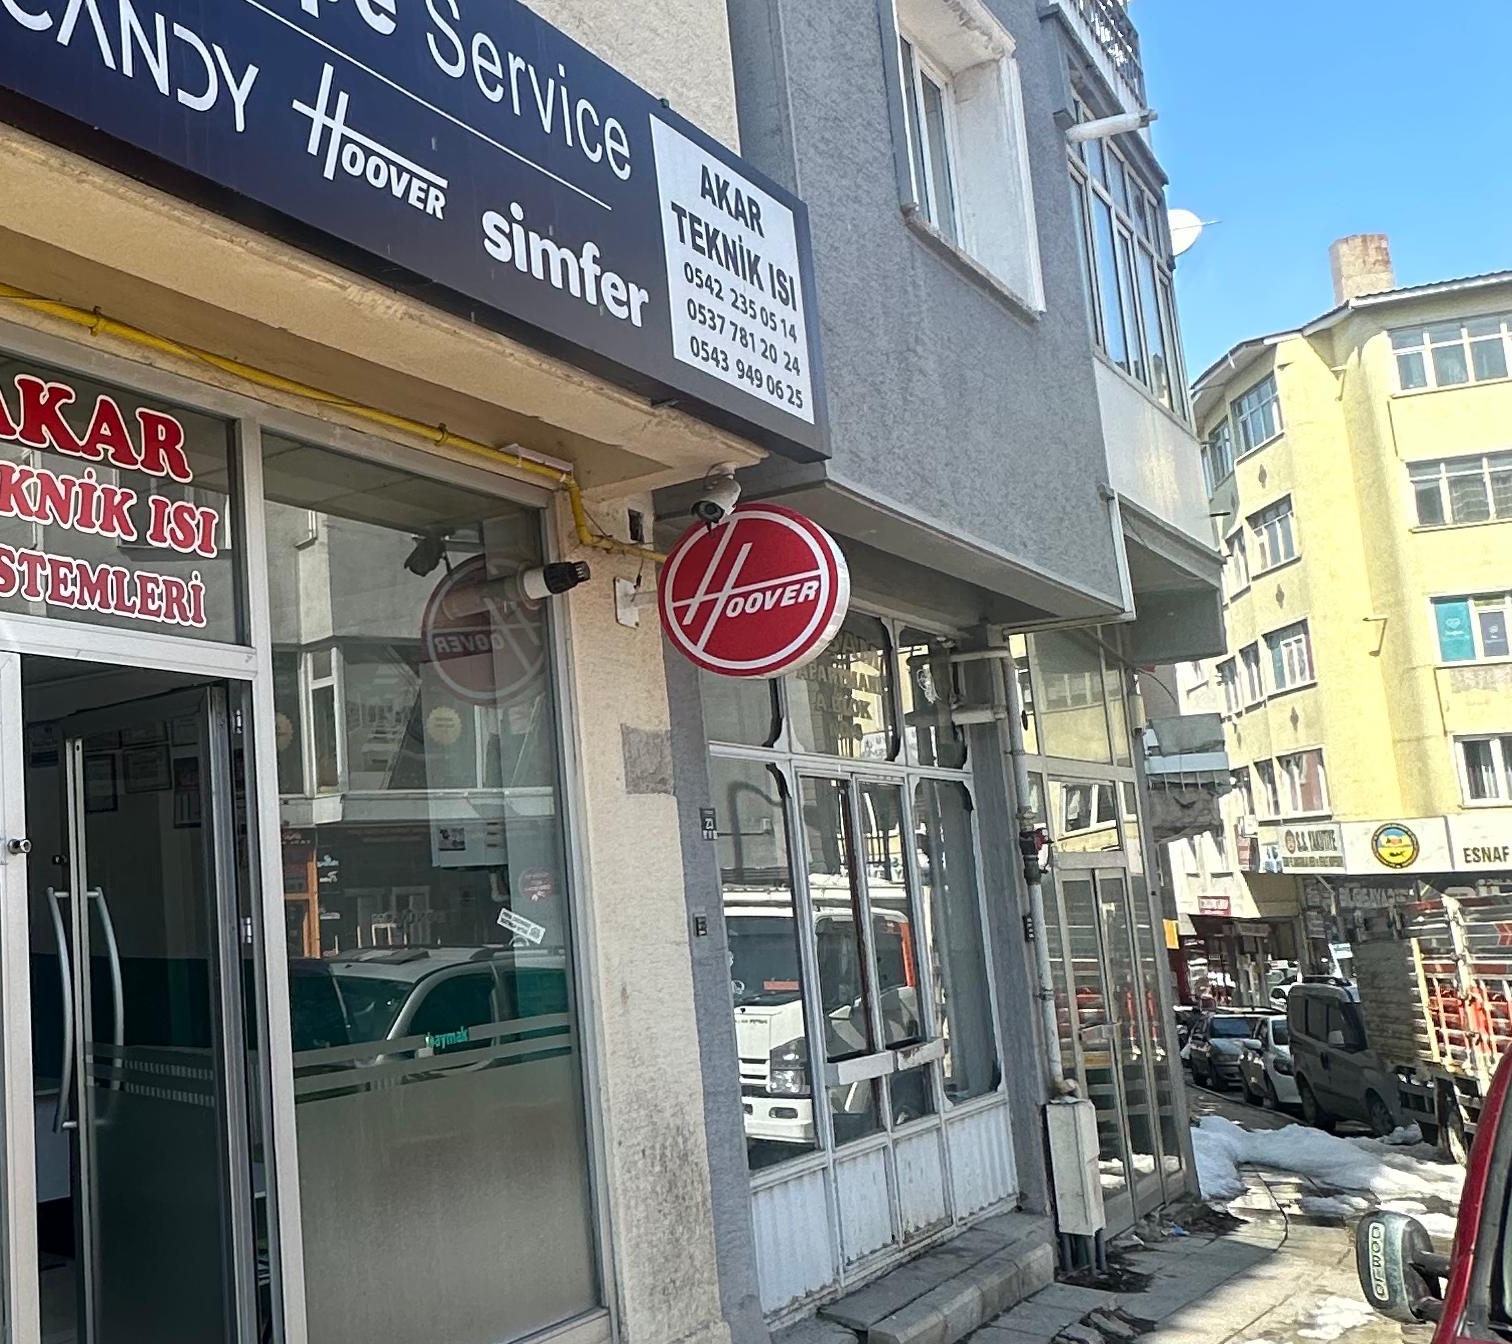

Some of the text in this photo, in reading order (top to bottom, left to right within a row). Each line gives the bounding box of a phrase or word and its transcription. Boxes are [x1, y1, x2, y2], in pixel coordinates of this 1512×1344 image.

[700, 163, 765, 238] AKAR
[483, 201, 651, 329] simfer
[671, 200, 797, 312] TEKNİK ISI
[684, 261, 797, 344] 0542 235 05 14
[687, 298, 800, 376] 0537 781 20 24
[690, 335, 803, 409] 0543 949 06 25
[146, 494, 219, 557] ISI
[1462, 845, 1510, 864] ESNAF
